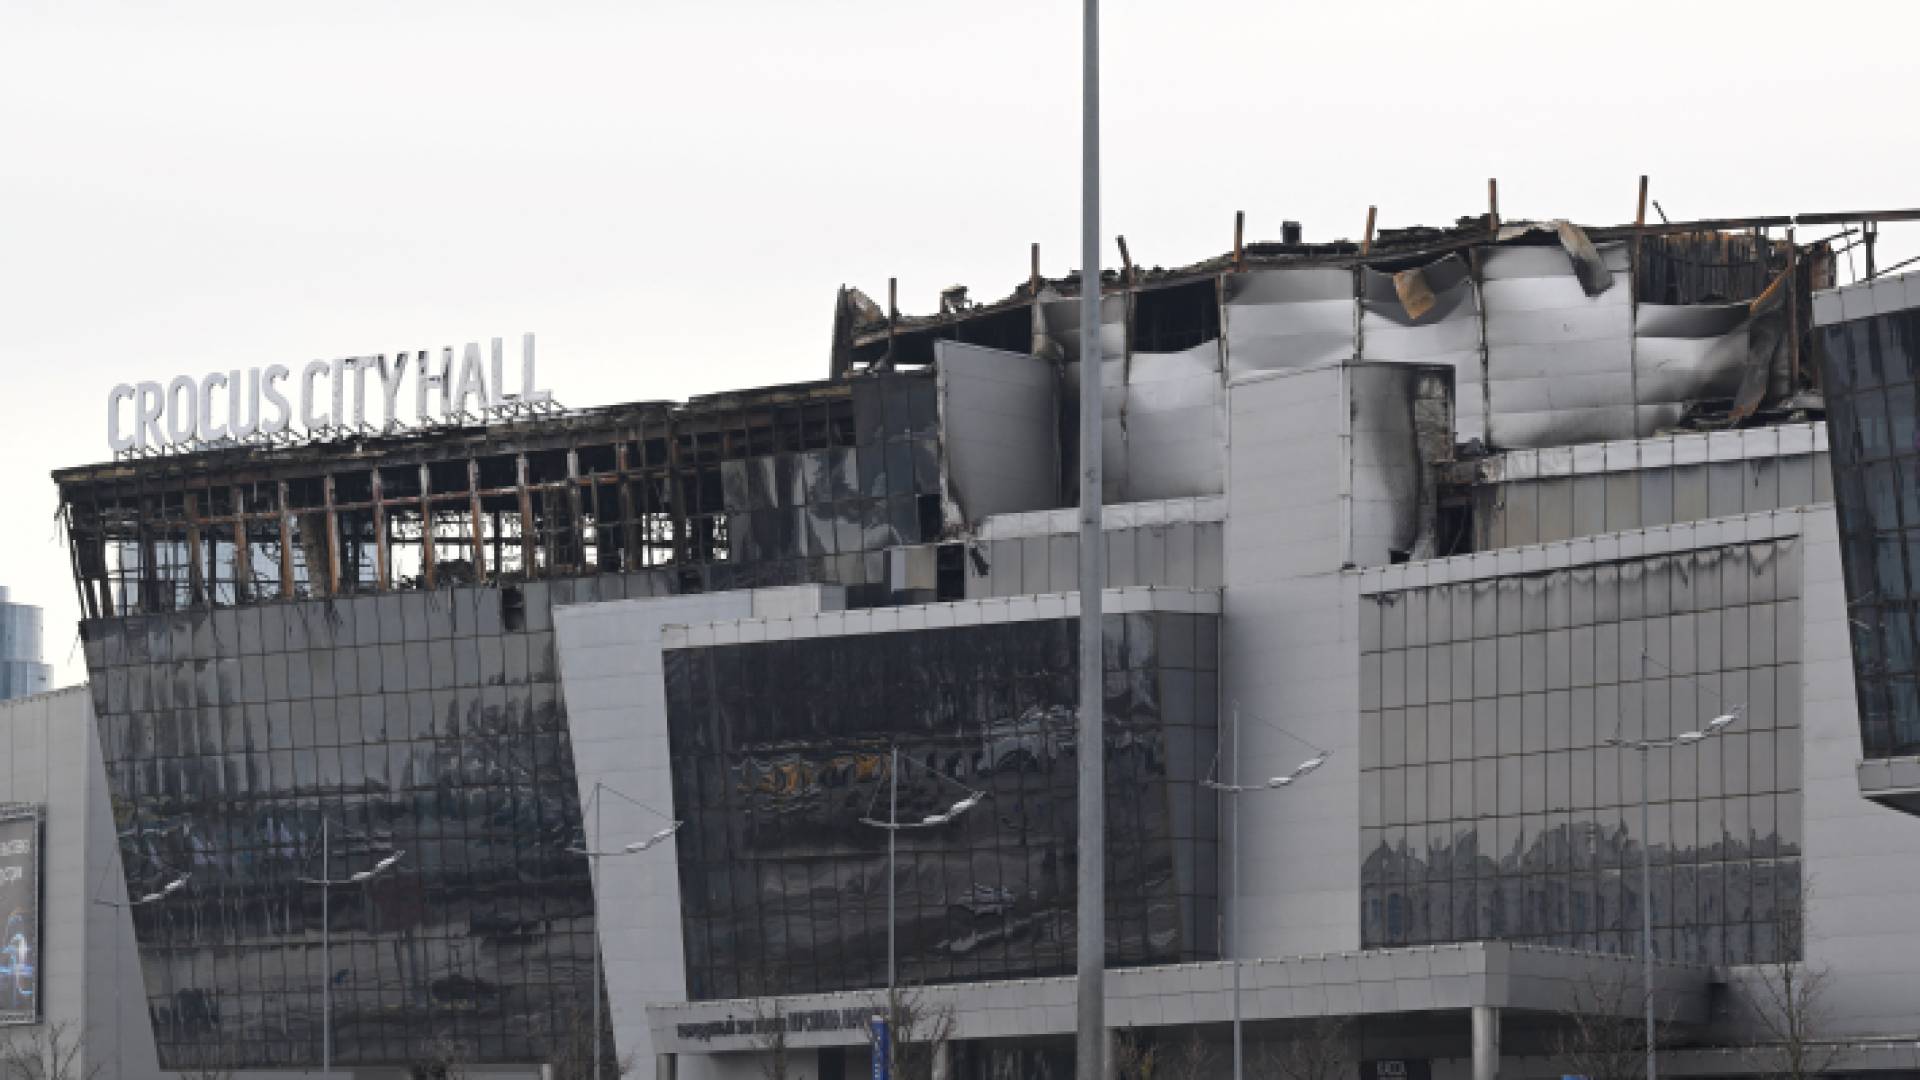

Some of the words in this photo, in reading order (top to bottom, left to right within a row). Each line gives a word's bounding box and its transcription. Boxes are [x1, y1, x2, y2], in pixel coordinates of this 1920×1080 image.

[108, 364, 291, 450] CROCUS
[302, 354, 408, 432] CITY
[416, 332, 552, 418] HALL
